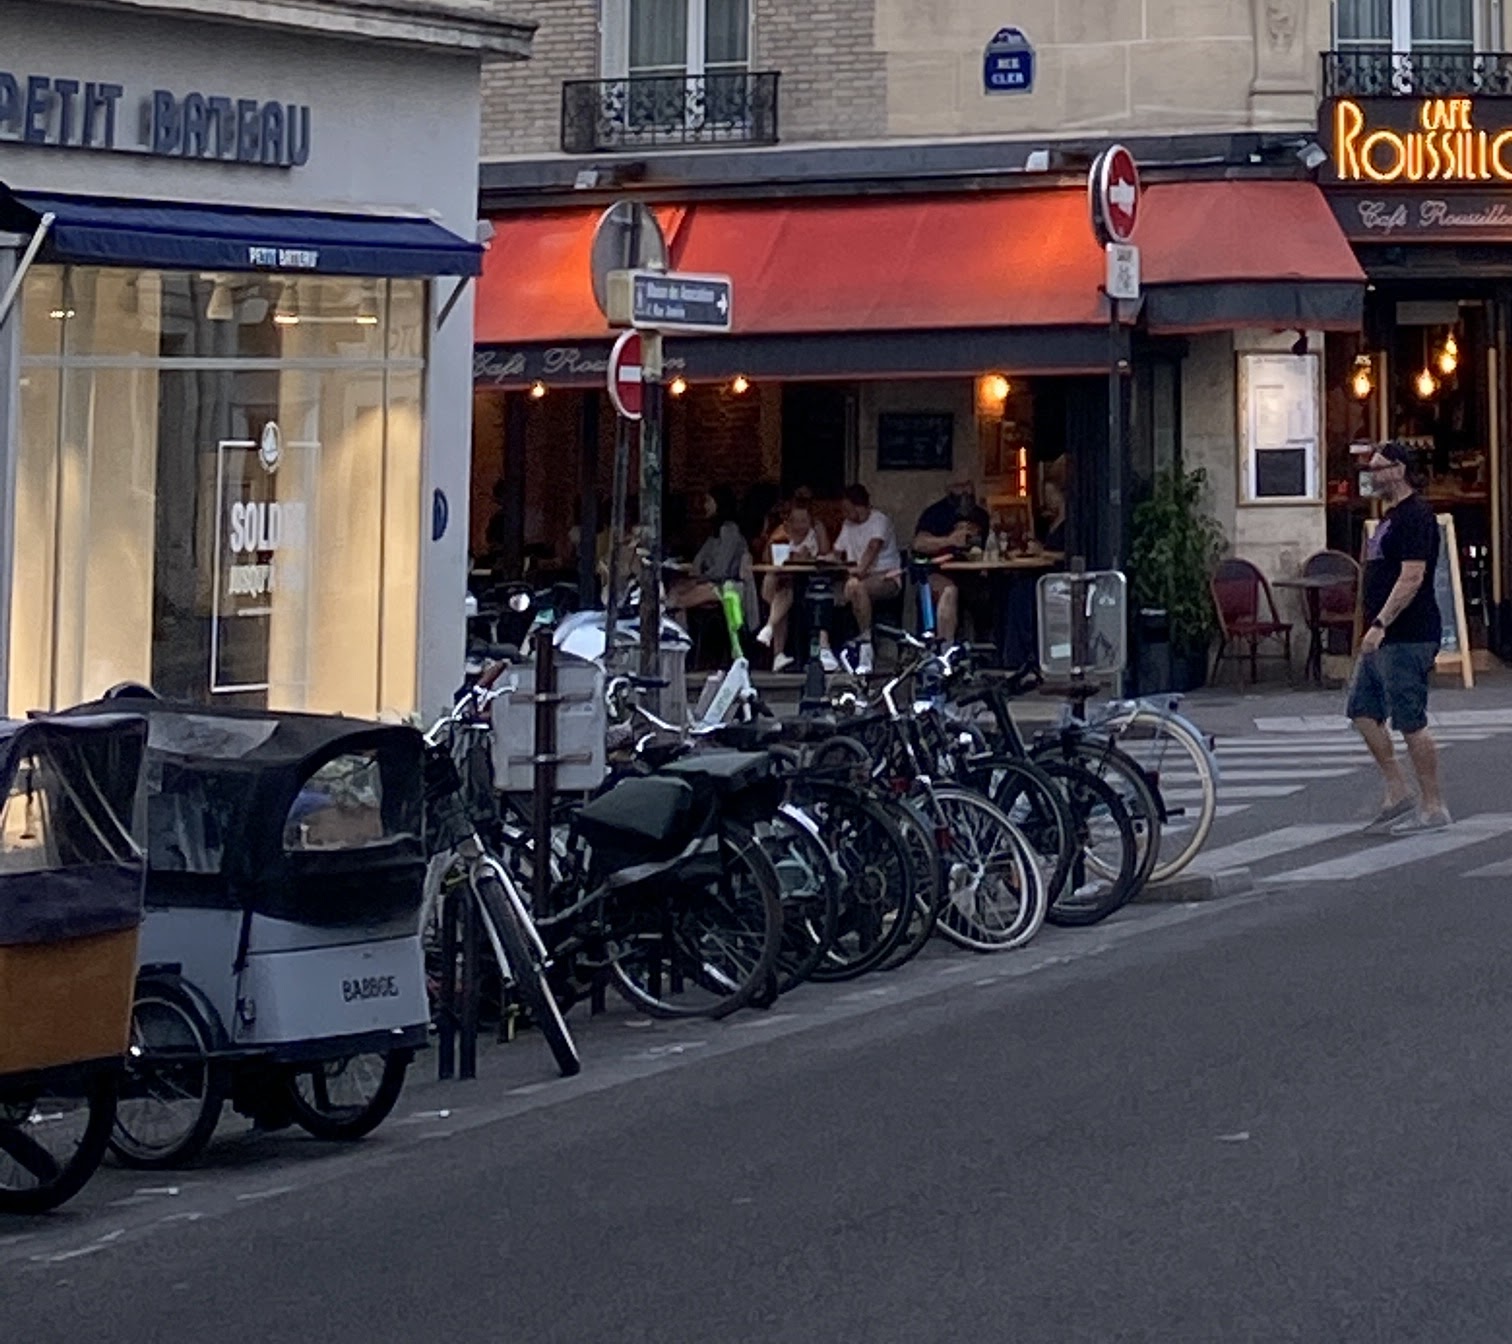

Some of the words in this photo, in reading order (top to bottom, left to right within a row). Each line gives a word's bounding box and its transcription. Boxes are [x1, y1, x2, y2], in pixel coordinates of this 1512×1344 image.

[0, 72, 122, 150] PETIT
[153, 90, 310, 166] BATEAU
[1422, 99, 1474, 130] CAFE
